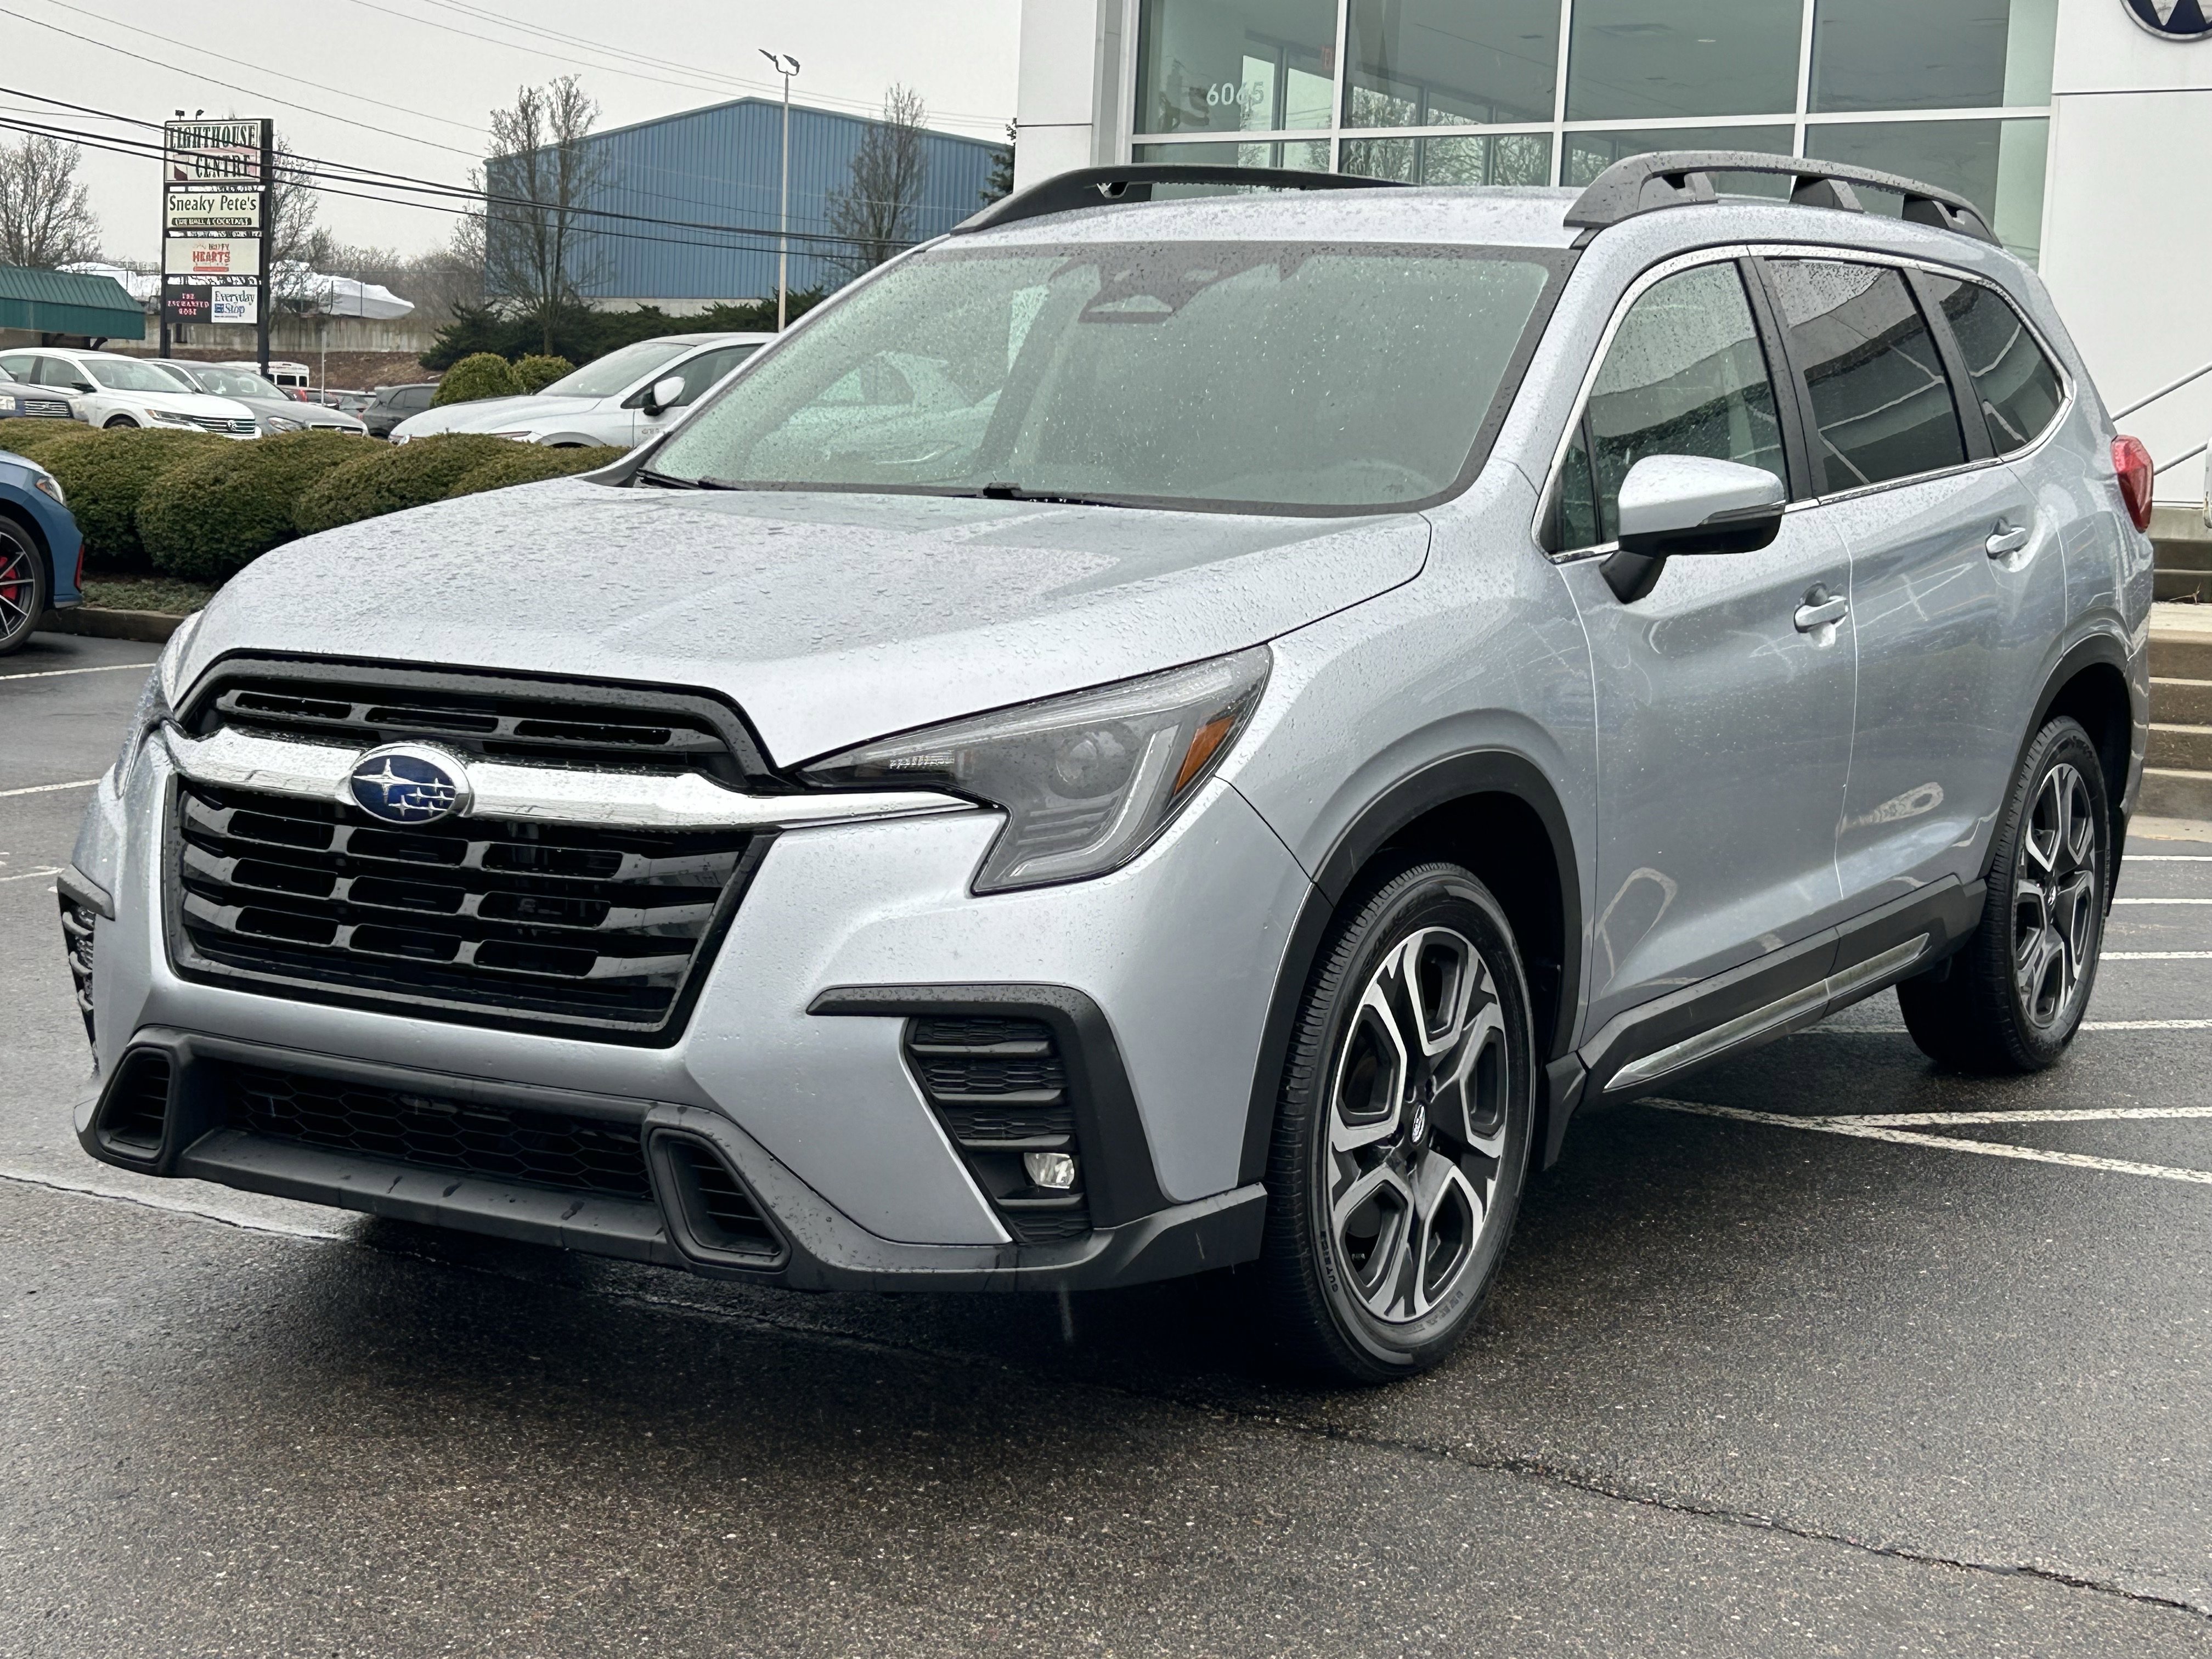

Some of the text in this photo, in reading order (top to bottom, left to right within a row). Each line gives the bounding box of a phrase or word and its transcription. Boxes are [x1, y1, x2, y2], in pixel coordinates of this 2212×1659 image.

[1206, 82, 1264, 106] 6065
[170, 195, 257, 214] Sneaky Pete's
[193, 251, 230, 262] HEARTS
[215, 290, 255, 306] Everyday
[225, 303, 245, 317] Stop
